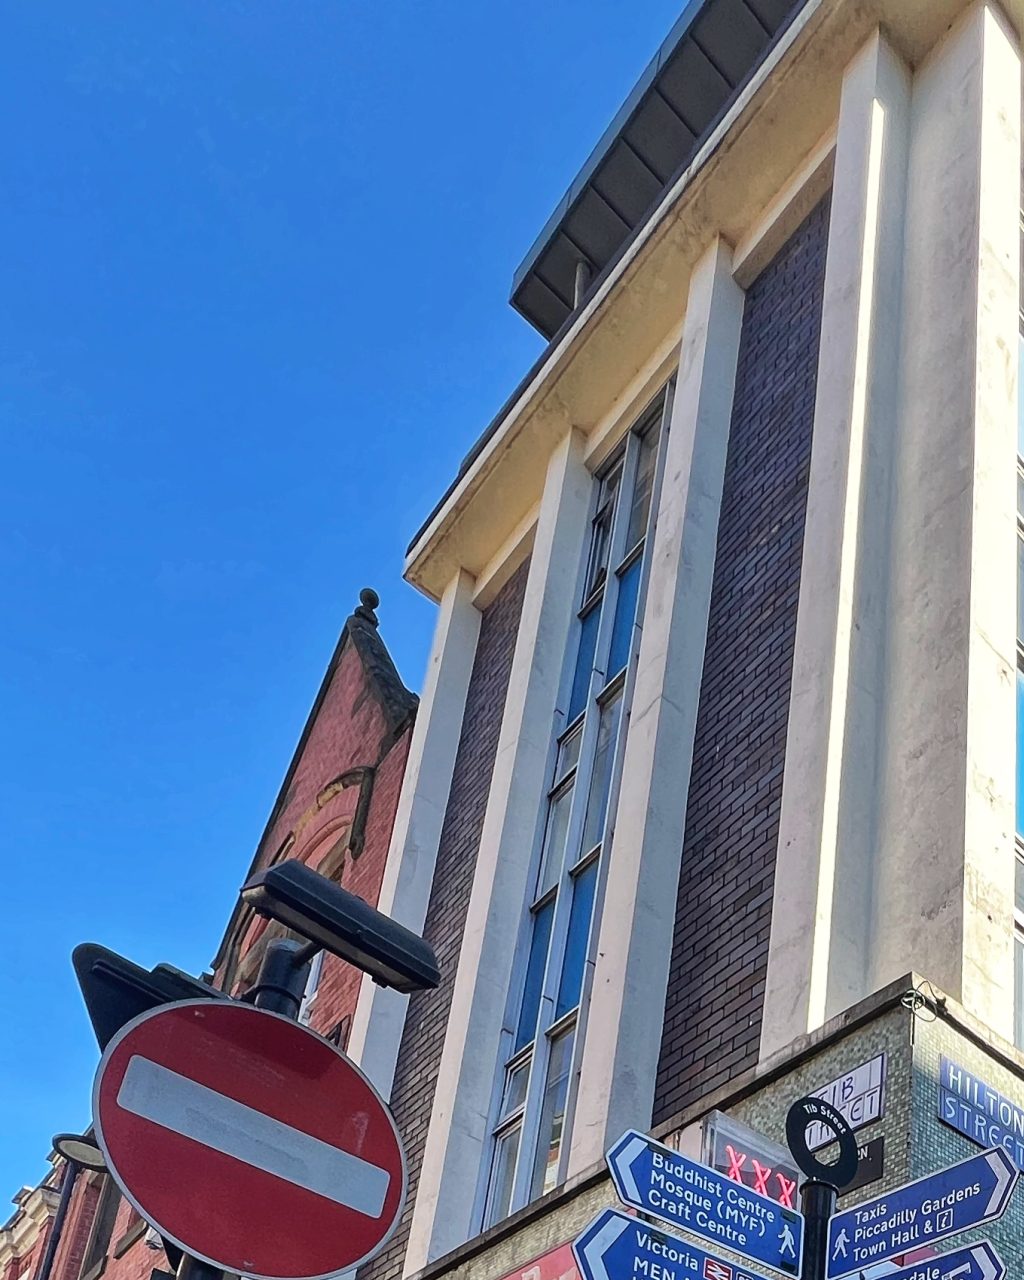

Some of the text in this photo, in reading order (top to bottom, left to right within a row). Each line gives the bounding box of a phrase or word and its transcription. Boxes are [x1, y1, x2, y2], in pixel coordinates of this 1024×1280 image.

[803, 1104, 847, 1135] Tib Street
[949, 1065, 1024, 1137] HILTON
[650, 1170, 766, 1237] Mosque (MYF)
[652, 1152, 775, 1223] Buddhist Centre
[854, 1182, 981, 1243] Piccadilly Gardens
[855, 1204, 887, 1225] Taxis
[648, 1190, 747, 1246] Craft Centre
[853, 1222, 933, 1262] Town Hall &
[635, 1230, 699, 1272] Victoria
